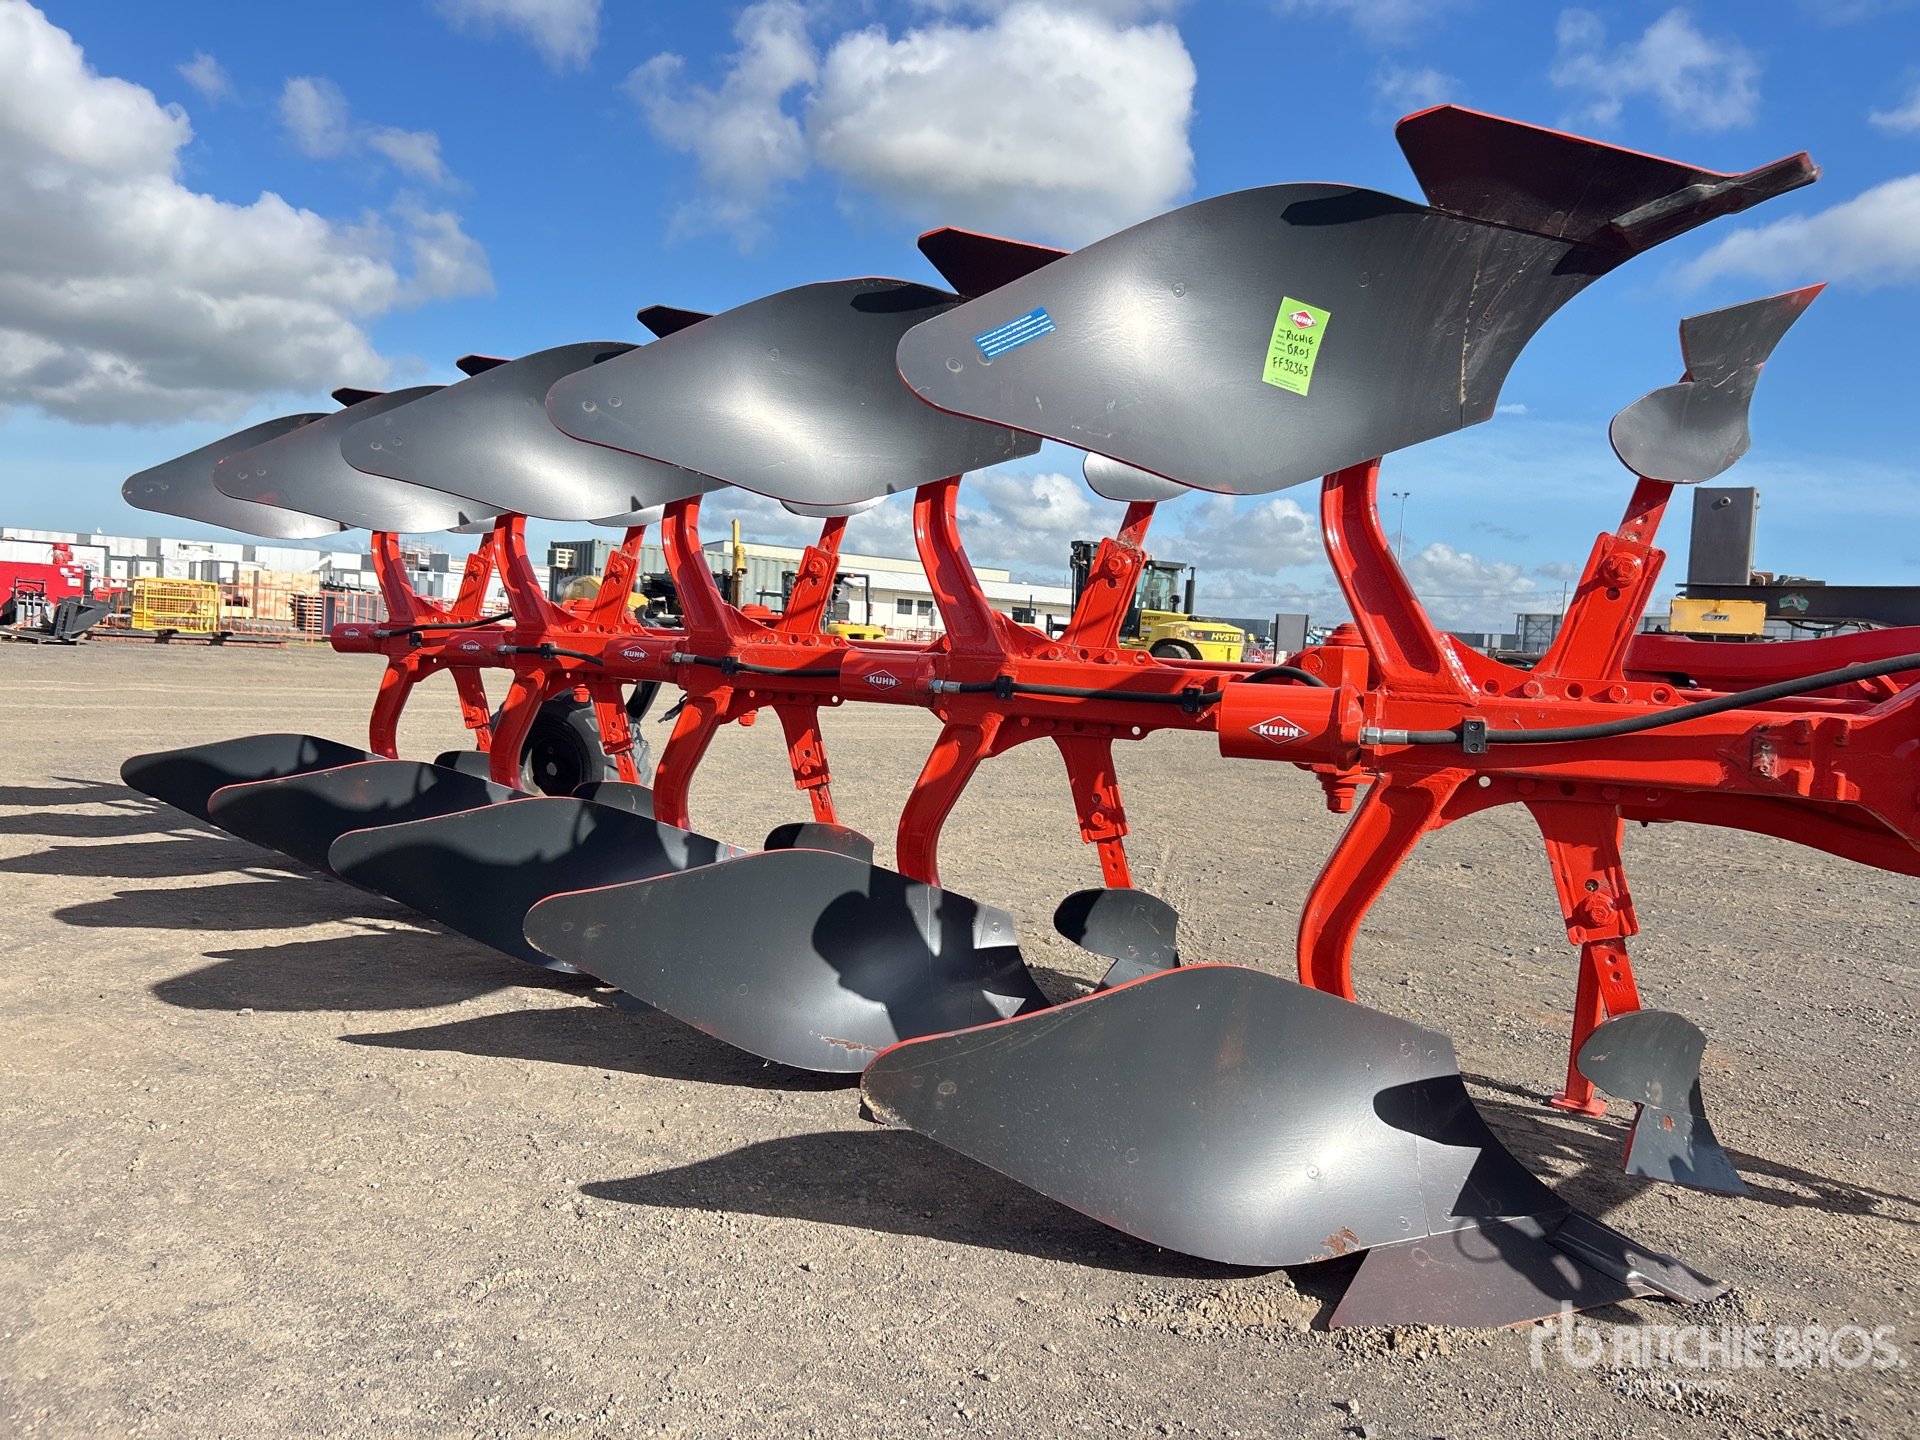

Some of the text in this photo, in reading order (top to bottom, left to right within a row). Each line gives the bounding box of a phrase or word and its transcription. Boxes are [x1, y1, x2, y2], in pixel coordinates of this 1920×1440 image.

[1292, 314, 1313, 326] KUHN
[1286, 330, 1314, 345] RICHIE
[1287, 344, 1310, 359] BROS
[1272, 357, 1308, 377] FF32363
[624, 650, 646, 659] KUHN
[868, 676, 898, 686] KUHN
[1259, 725, 1299, 737] KUHN
